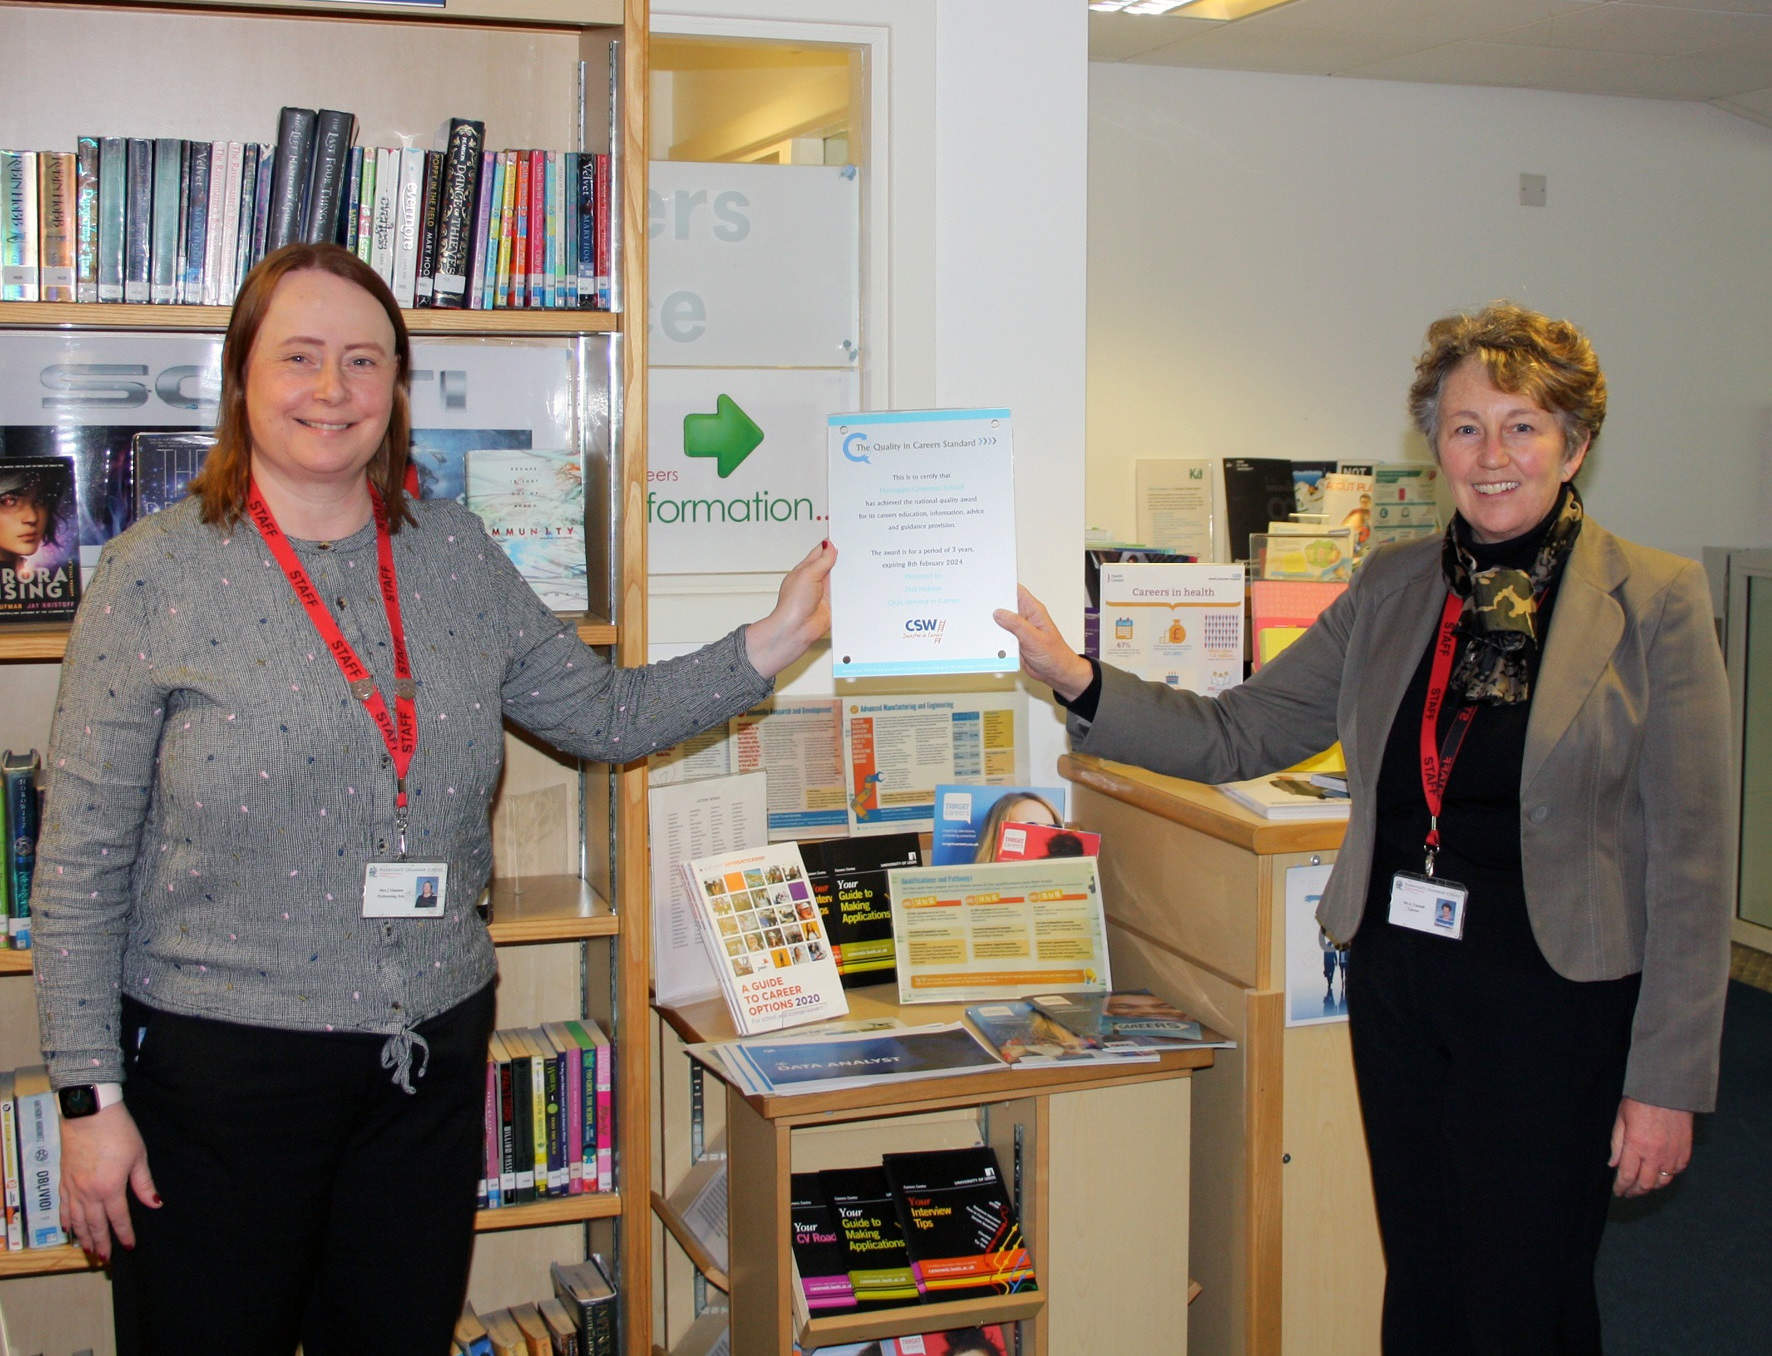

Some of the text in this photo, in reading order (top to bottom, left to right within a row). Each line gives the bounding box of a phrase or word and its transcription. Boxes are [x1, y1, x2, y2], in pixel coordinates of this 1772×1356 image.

[288, 130, 302, 150] LEFT
[326, 131, 339, 155] LAST
[230, 146, 241, 160] The
[195, 152, 207, 186] Velvet
[323, 157, 336, 184] FOUR
[452, 164, 467, 208] DANCE
[582, 163, 592, 196] Velvet
[8, 154, 23, 229] ROBIN HOBB
[48, 156, 64, 228] ROBIN HOBB
[318, 186, 332, 224] THINGS
[375, 196, 393, 250] everless
[401, 182, 418, 250] evermore
[424, 154, 440, 278] POPPY IN THE FIELD MARY HOO
[446, 217, 462, 274] THIEVES
[856, 438, 976, 452] The Quality in Careers Standard
[647, 470, 679, 482] eers
[1342, 466, 1367, 476] NOT
[877, 498, 902, 506] achieved
[939, 496, 958, 506] quality
[250, 501, 278, 536] STAFF
[492, 528, 574, 536] MMUNITY
[900, 522, 927, 532] guidance
[923, 547, 943, 556] period
[944, 546, 951, 554] of
[882, 560, 906, 569] expiring
[907, 560, 918, 568] 8th
[946, 558, 964, 566] 2024
[2, 566, 68, 584] RORA
[0, 582, 63, 600] SING
[290, 570, 320, 607] STAFF
[381, 566, 395, 603] STAFF
[1132, 588, 1215, 597] Careers in health
[904, 618, 938, 632] CSW
[1440, 622, 1456, 657] STAFF
[332, 640, 362, 678] STAFF
[860, 705, 883, 713] Advanced
[883, 704, 917, 712] Manufacturing
[926, 702, 954, 711] Engineering
[1426, 688, 1440, 720] STAFF
[376, 712, 399, 750] STAF
[402, 712, 412, 752] STAFF
[1424, 756, 1440, 796] STAFF
[1004, 836, 1025, 844] TARGET
[837, 879, 858, 890] Your
[816, 894, 833, 905] nterv
[838, 890, 874, 901] Guide to
[821, 908, 830, 917] ps
[841, 900, 871, 912] Making
[842, 910, 891, 924] Applications
[742, 976, 784, 994] A GUIDE
[744, 986, 802, 1005] TO CAREER
[748, 1000, 794, 1016] OPTIONS
[795, 994, 821, 1007] 2020
[1117, 1020, 1181, 1032] CAREERS
[778, 1055, 901, 1072] DATA ANALYST
[954, 1178, 978, 1186] UNIVERSITY
[908, 1196, 931, 1207] Your
[838, 1208, 863, 1218] Your
[910, 1206, 952, 1218] Interview
[794, 1222, 818, 1233] Your
[842, 1218, 882, 1229] Guide to
[914, 1218, 935, 1230] Tips
[796, 1234, 810, 1244] CV
[846, 1229, 880, 1240] Making
[849, 1238, 906, 1252] Applications
